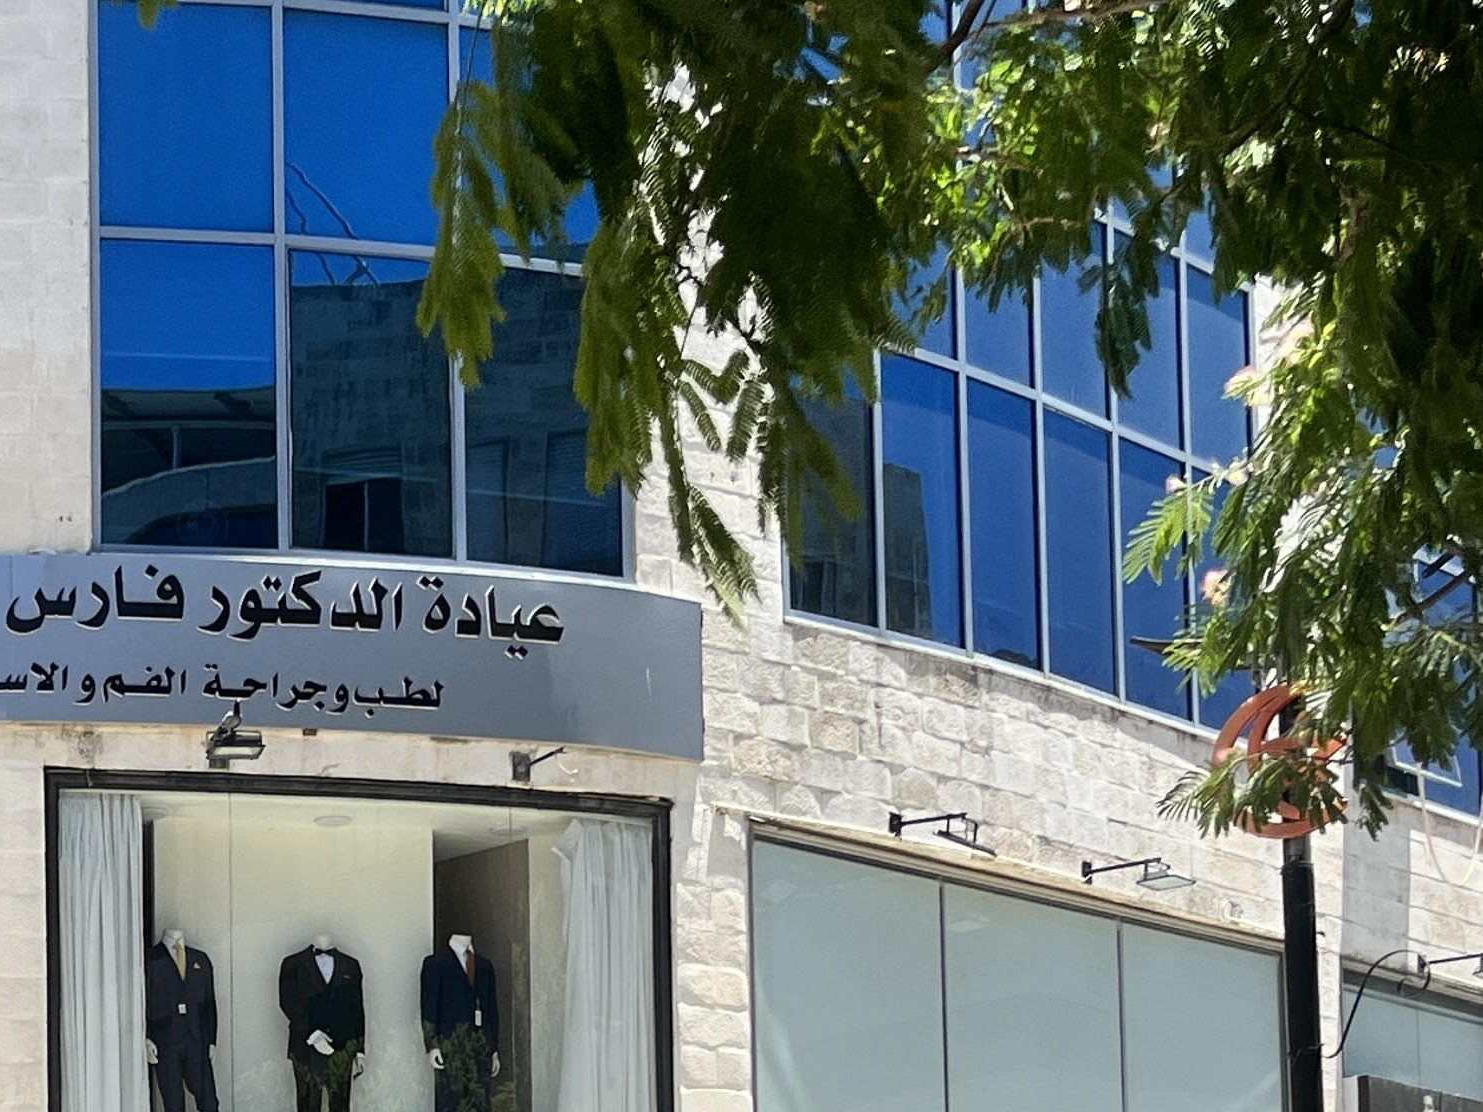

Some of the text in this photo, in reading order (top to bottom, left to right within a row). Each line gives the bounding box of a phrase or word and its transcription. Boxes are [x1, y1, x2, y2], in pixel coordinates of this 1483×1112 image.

[6, 564, 185, 633] فارس
[197, 570, 403, 641] الدكتور
[416, 575, 564, 659] عيادة
[103, 665, 186, 702] الفم
